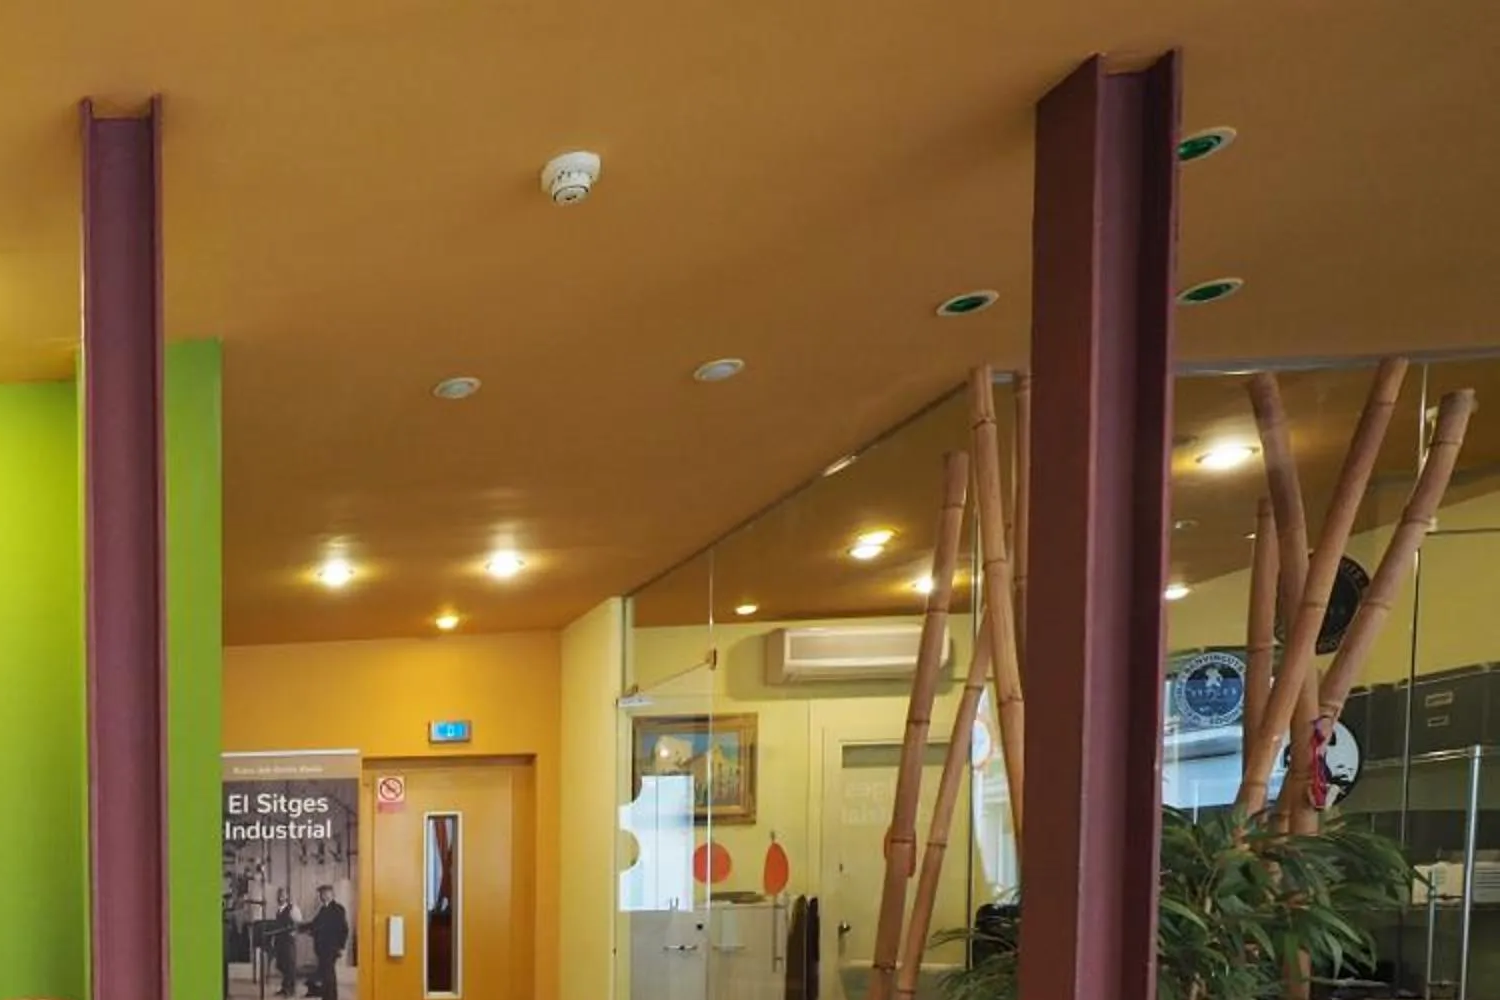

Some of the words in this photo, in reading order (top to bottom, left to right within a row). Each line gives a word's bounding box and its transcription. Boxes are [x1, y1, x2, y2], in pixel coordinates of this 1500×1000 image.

[228, 794, 249, 814] El
[257, 793, 329, 818] Sitges
[225, 819, 332, 840] Industrial
